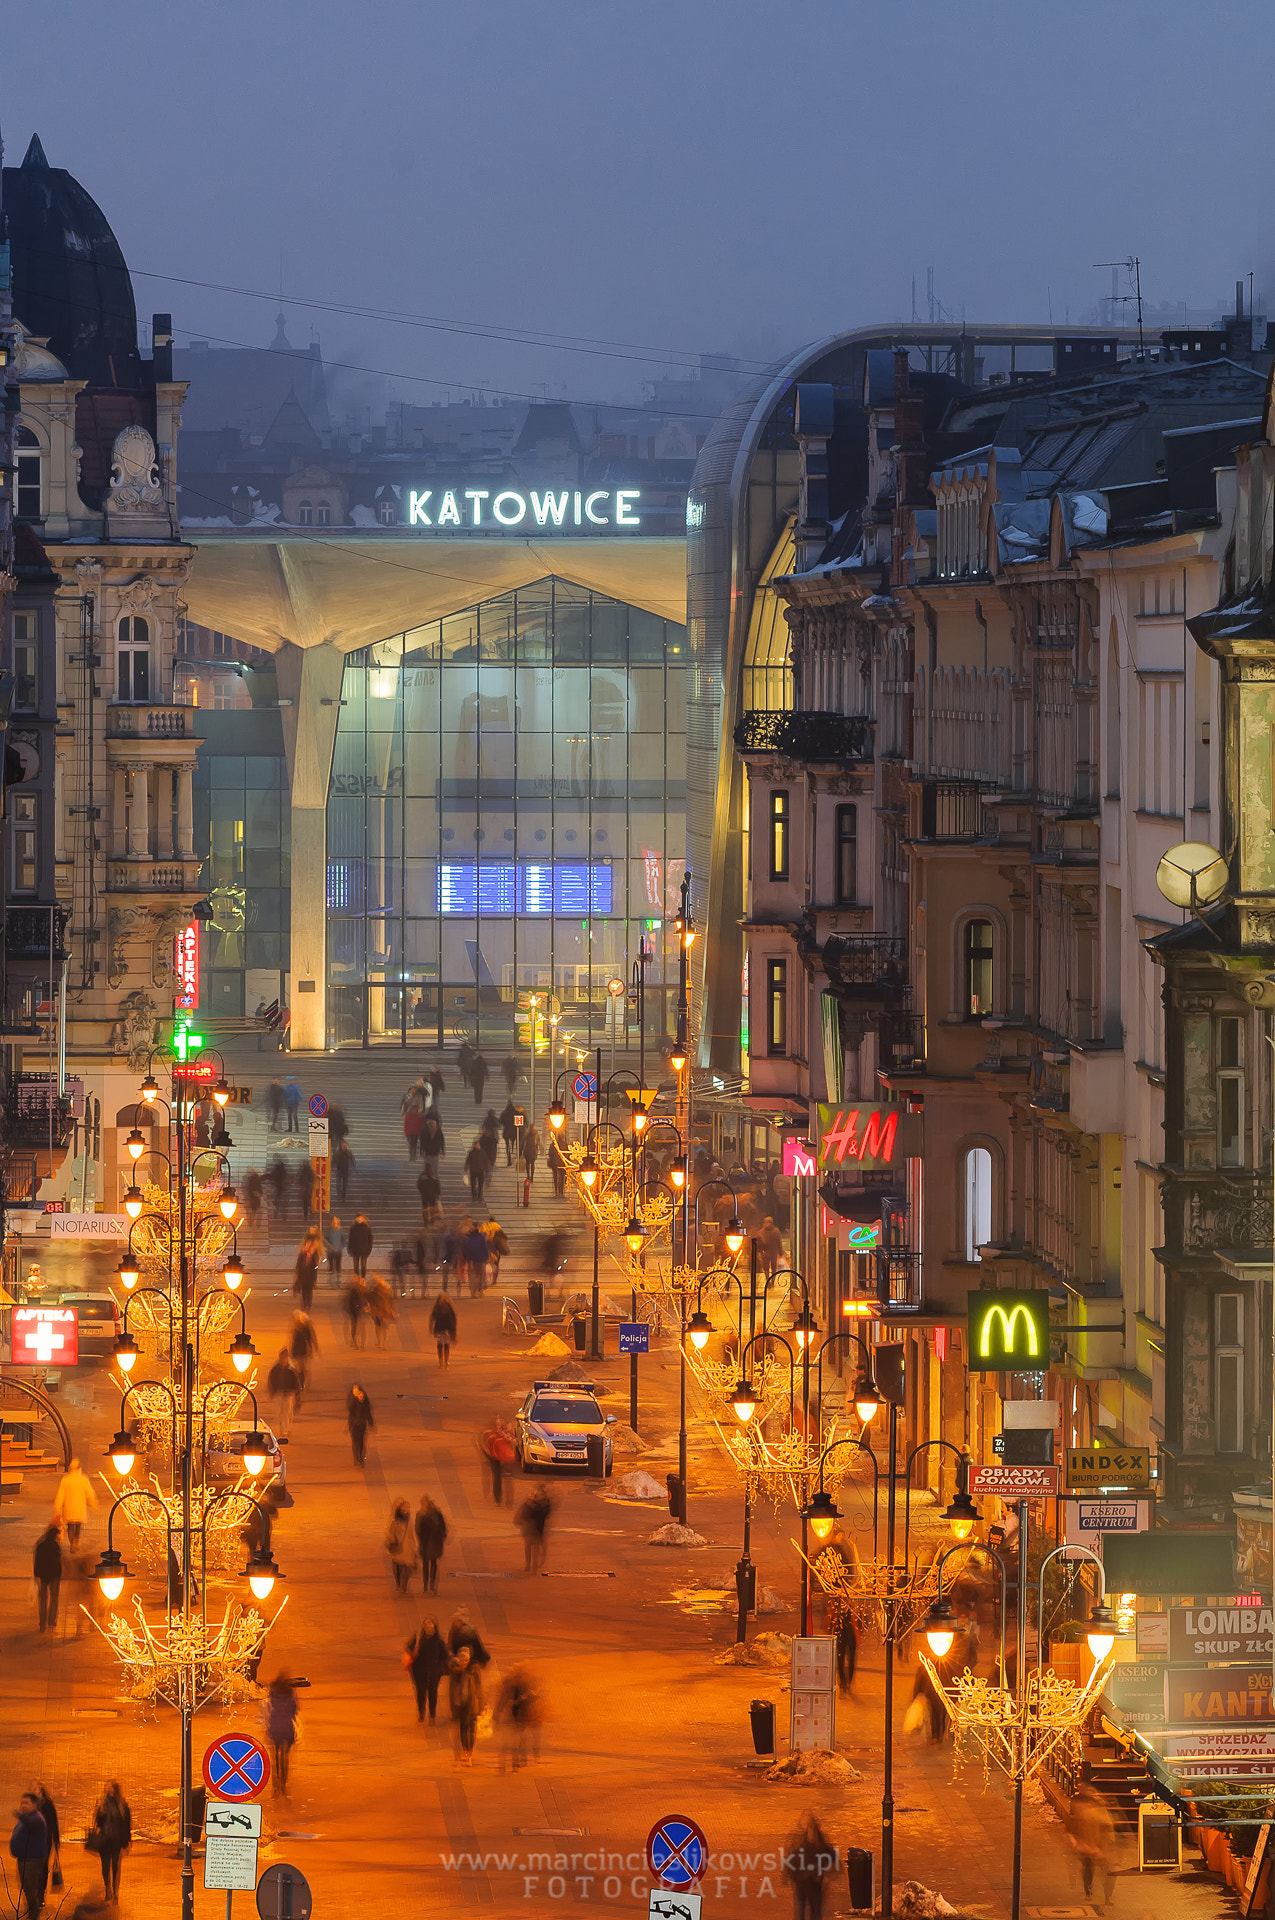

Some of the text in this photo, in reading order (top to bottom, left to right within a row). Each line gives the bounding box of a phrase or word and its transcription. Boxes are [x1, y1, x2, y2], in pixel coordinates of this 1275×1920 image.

[409, 490, 641, 526] KATOWICE
[184, 926, 196, 994] APTEKA
[821, 1109, 900, 1164] H&M
[54, 1220, 125, 1234] NOTARIUSZ
[15, 1308, 75, 1322] APTEKA
[620, 1334, 647, 1344] Policja
[1072, 1454, 1143, 1471] INDEX
[980, 1468, 1046, 1478] OBIADY
[1071, 1472, 1144, 1482] BIURO PODRÓŻY
[974, 1476, 1051, 1486] DOMOWE
[973, 1486, 1054, 1495] kuchnia tradycyjna
[1090, 1507, 1127, 1516] KSERO
[1082, 1517, 1135, 1528] CENTRUM
[1194, 1640, 1241, 1654] SKUP
[1118, 1666, 1158, 1677] KSERO
